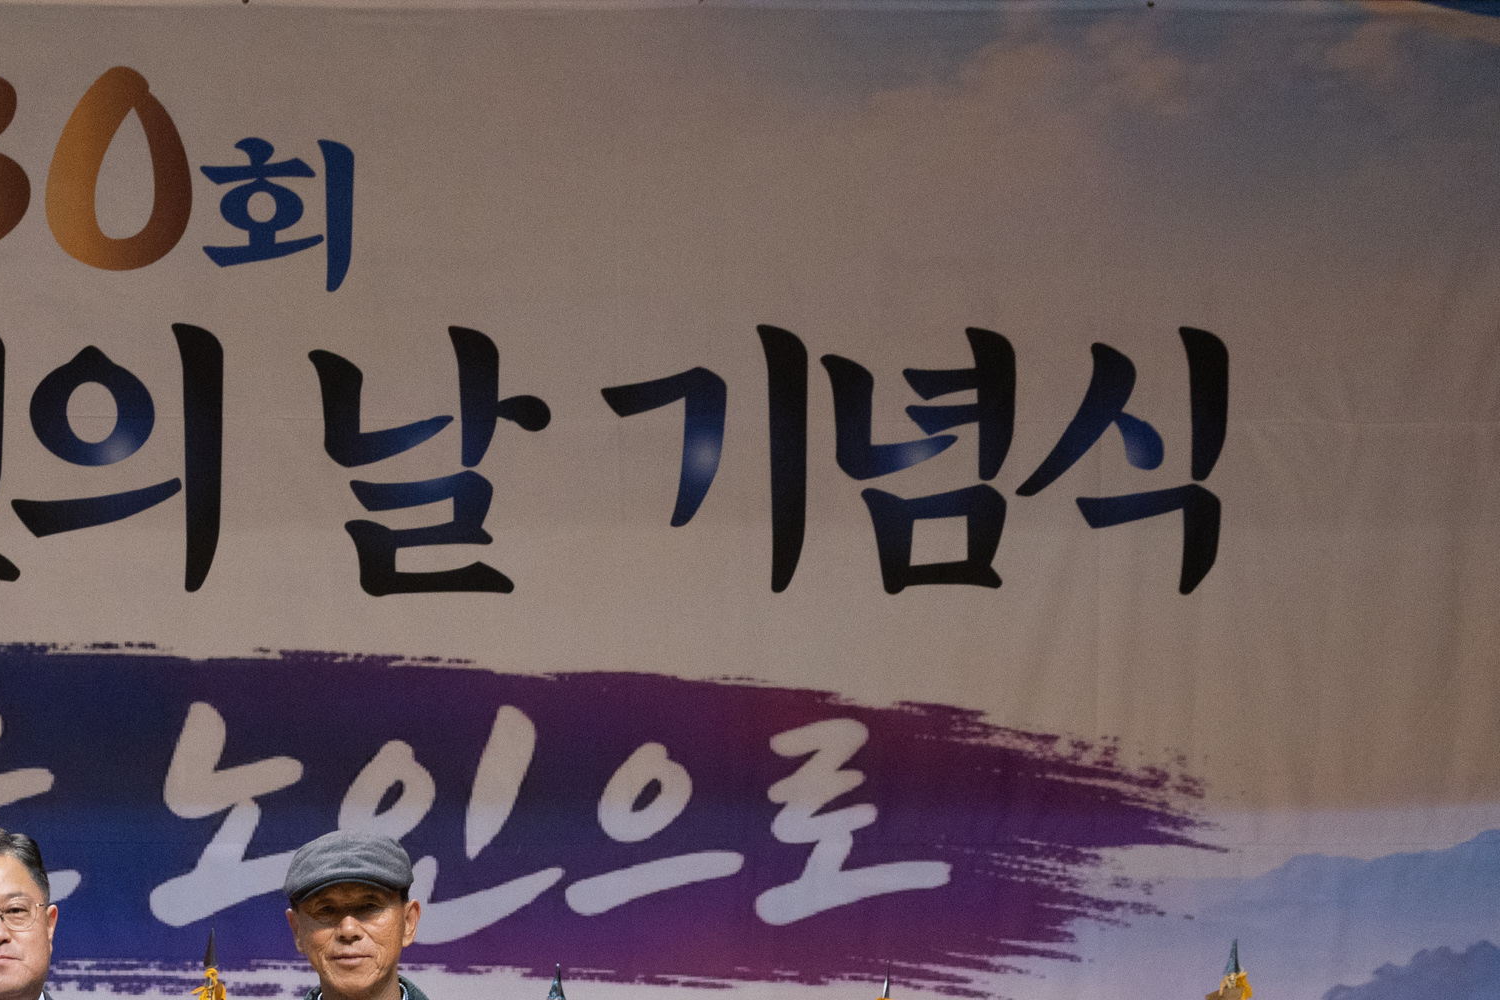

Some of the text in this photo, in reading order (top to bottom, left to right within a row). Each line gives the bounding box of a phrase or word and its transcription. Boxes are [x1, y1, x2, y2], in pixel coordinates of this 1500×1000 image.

[307, 324, 552, 598] 날
[600, 323, 1230, 596] 기념식
[148, 700, 953, 945] 노인으로
